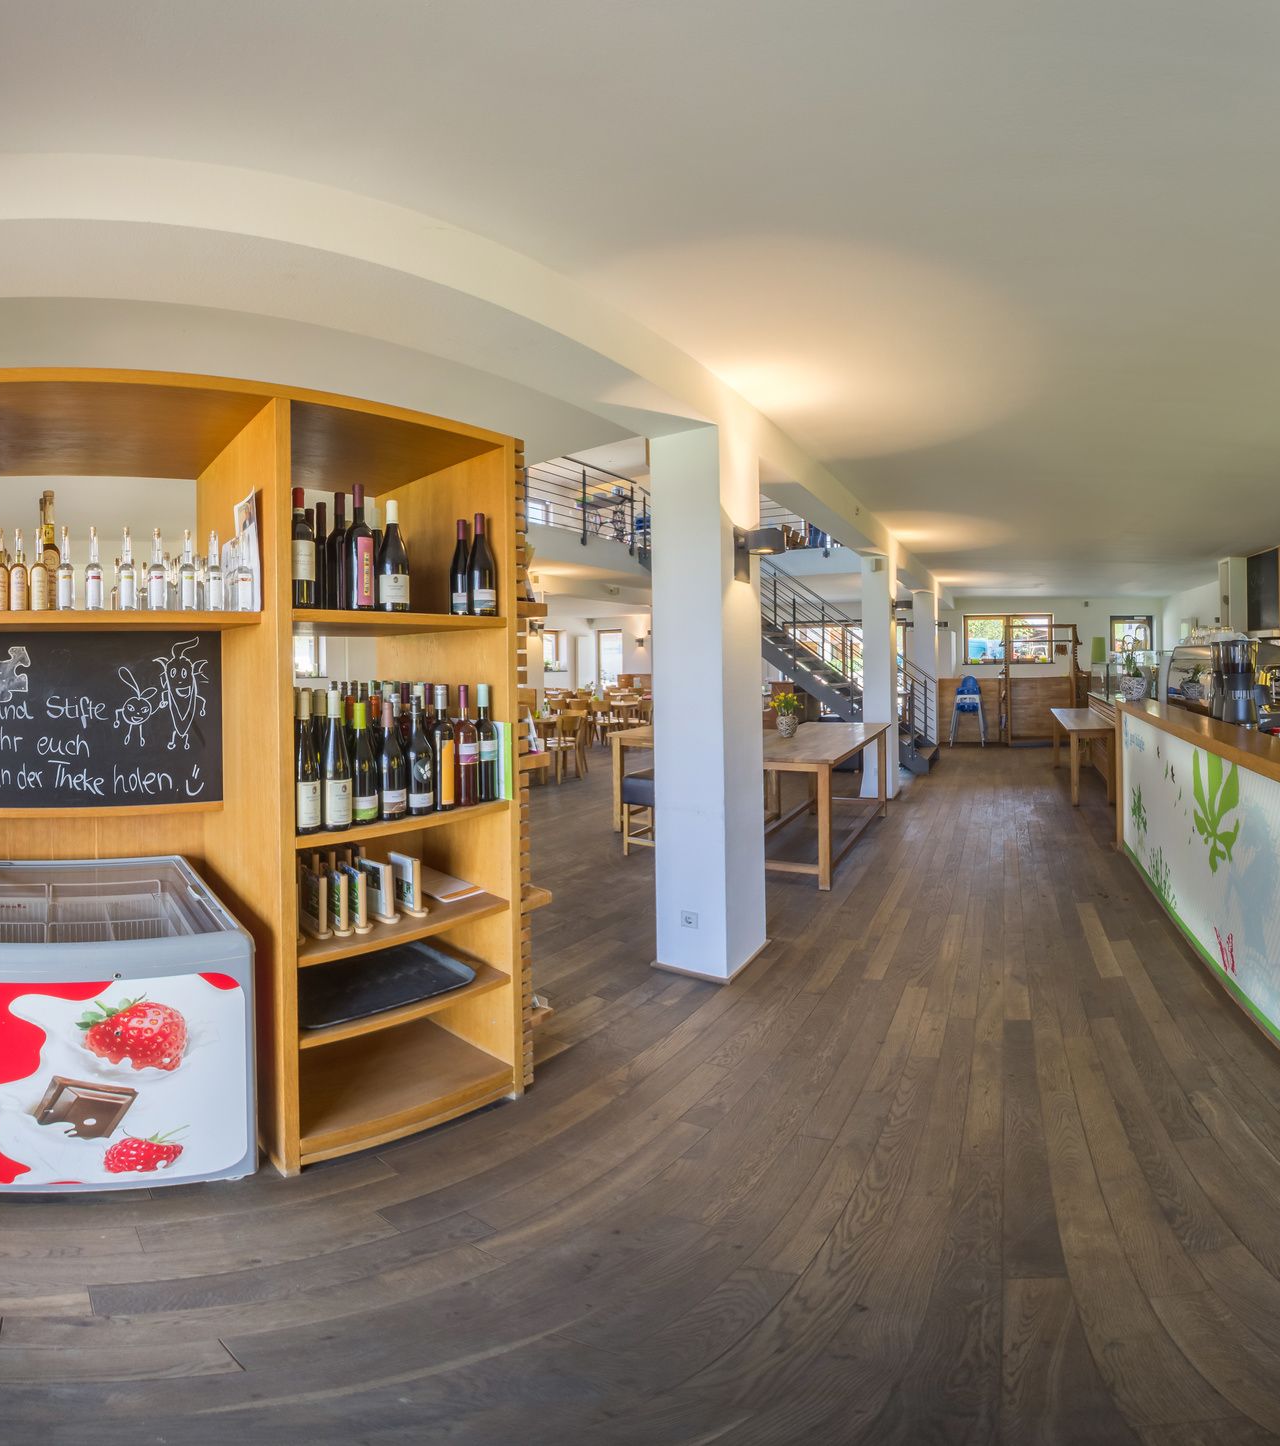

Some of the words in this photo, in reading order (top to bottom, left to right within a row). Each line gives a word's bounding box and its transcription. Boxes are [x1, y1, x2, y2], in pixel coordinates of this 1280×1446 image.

[46, 695, 109, 728] Stifte
[36, 734, 90, 758] euch
[17, 762, 44, 790] der
[48, 760, 105, 796] Theke
[113, 764, 180, 795] holen.
